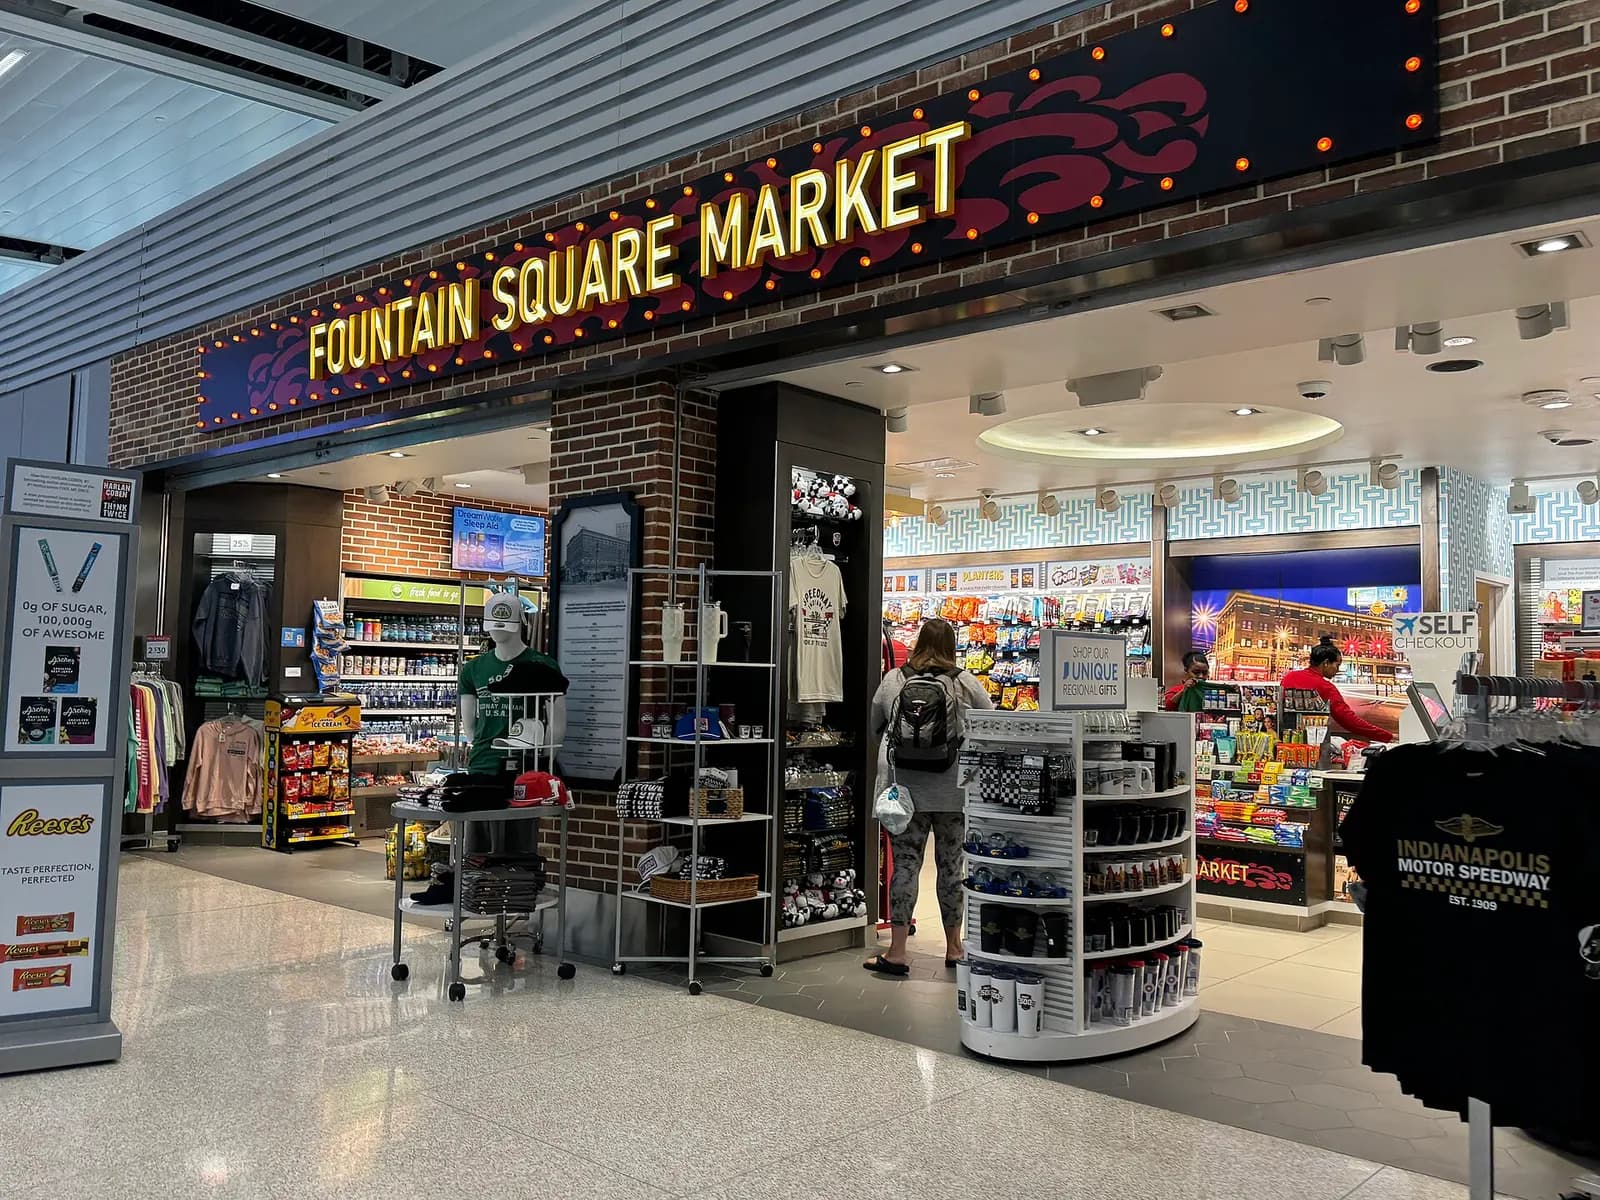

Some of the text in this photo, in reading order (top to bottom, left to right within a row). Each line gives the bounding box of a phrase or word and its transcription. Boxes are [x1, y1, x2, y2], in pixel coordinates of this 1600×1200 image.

[309, 121, 971, 381] FOUNTAIN SQUARE MARKET
[103, 482, 131, 492] HARLAN
[106, 489, 128, 498] COBEN
[103, 502, 128, 512] THINK
[103, 509, 127, 519] TWICE
[463, 518, 499, 530] Sleep Aid
[962, 569, 1005, 583] PLANTERS
[803, 587, 833, 609] SPEEDWAY
[23, 600, 107, 616] 0g OF SUGAR,
[38, 615, 93, 628] 100,000g
[1419, 615, 1475, 635] SELF
[22, 628, 105, 640] OF AWESOME
[1394, 636, 1475, 649] CHECKOUT
[1072, 646, 1109, 660] SHOP OUR
[1071, 662, 1118, 681] UNIQUE
[1063, 683, 1118, 696] REGIONAL GIFTS
[7, 808, 95, 837] Reese's
[1396, 839, 1551, 874] INDIANAPOLIS
[1, 863, 95, 875] TASTE PERFECTION,
[1397, 858, 1551, 891] MOTOR SPEEDWAY
[21, 874, 75, 884] PERFECTED
[1449, 895, 1498, 911] EST. 1909
